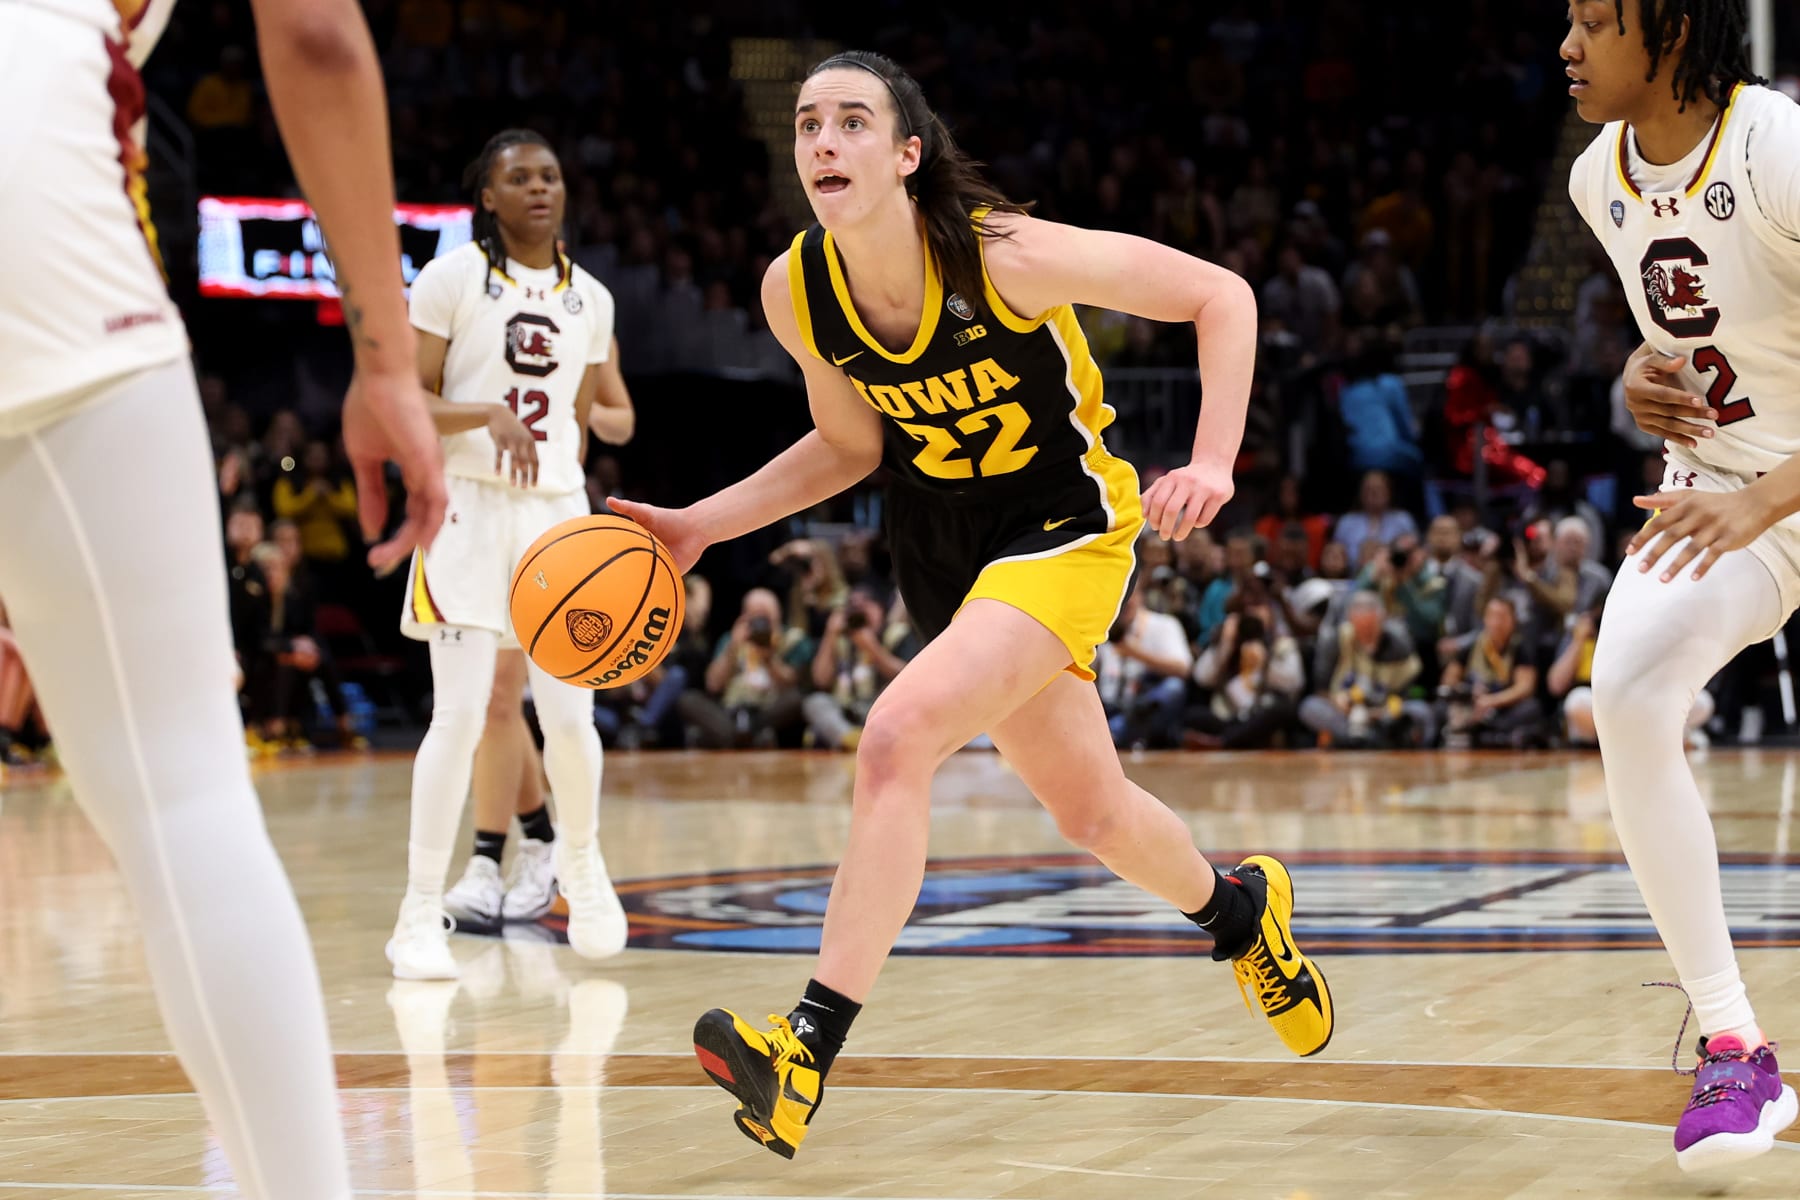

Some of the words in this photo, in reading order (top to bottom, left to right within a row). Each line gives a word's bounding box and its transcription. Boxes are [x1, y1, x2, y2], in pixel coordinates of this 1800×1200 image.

[1706, 183, 1733, 219] SEC
[504, 387, 549, 441] 12
[849, 358, 1021, 418] IOWA
[1692, 345, 1755, 427] 2
[893, 402, 1039, 479] 22
[573, 614, 597, 639] FOUR
[581, 621, 604, 644] FINAL
[584, 606, 671, 687] Wilson
